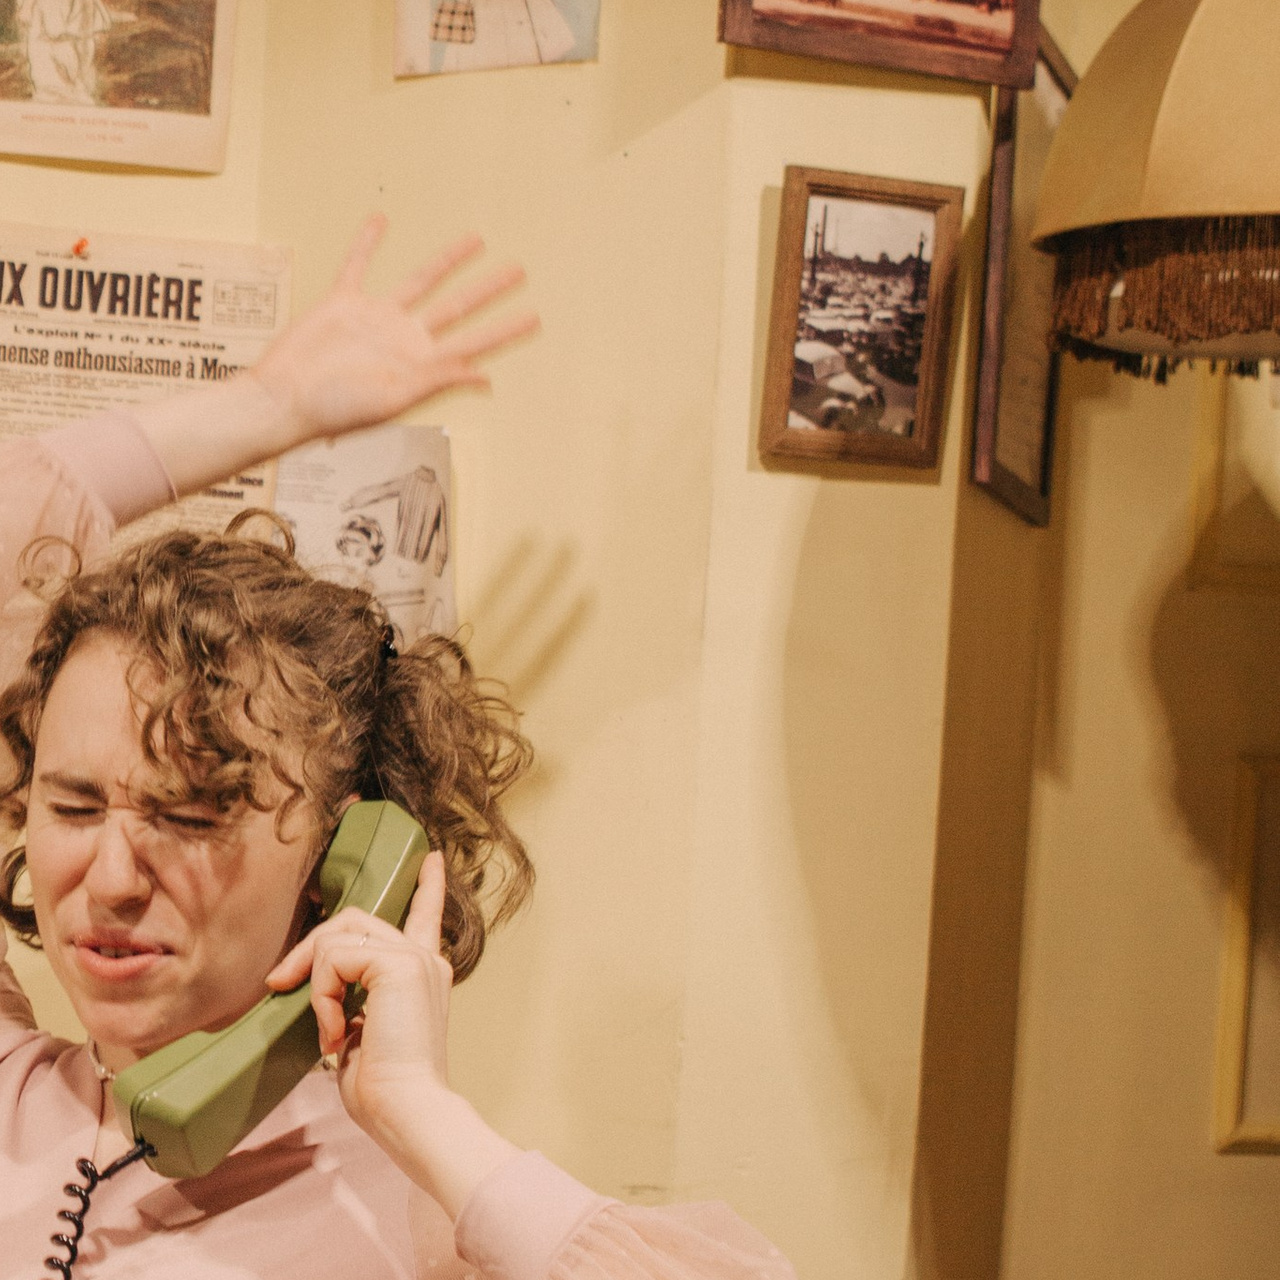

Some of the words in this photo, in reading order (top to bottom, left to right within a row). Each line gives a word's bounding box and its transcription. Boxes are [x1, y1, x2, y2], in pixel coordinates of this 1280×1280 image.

[39, 267, 203, 323] OUVRIÈRE
[14, 325, 79, 340] L'exploit
[54, 346, 188, 378] enthousiasme
